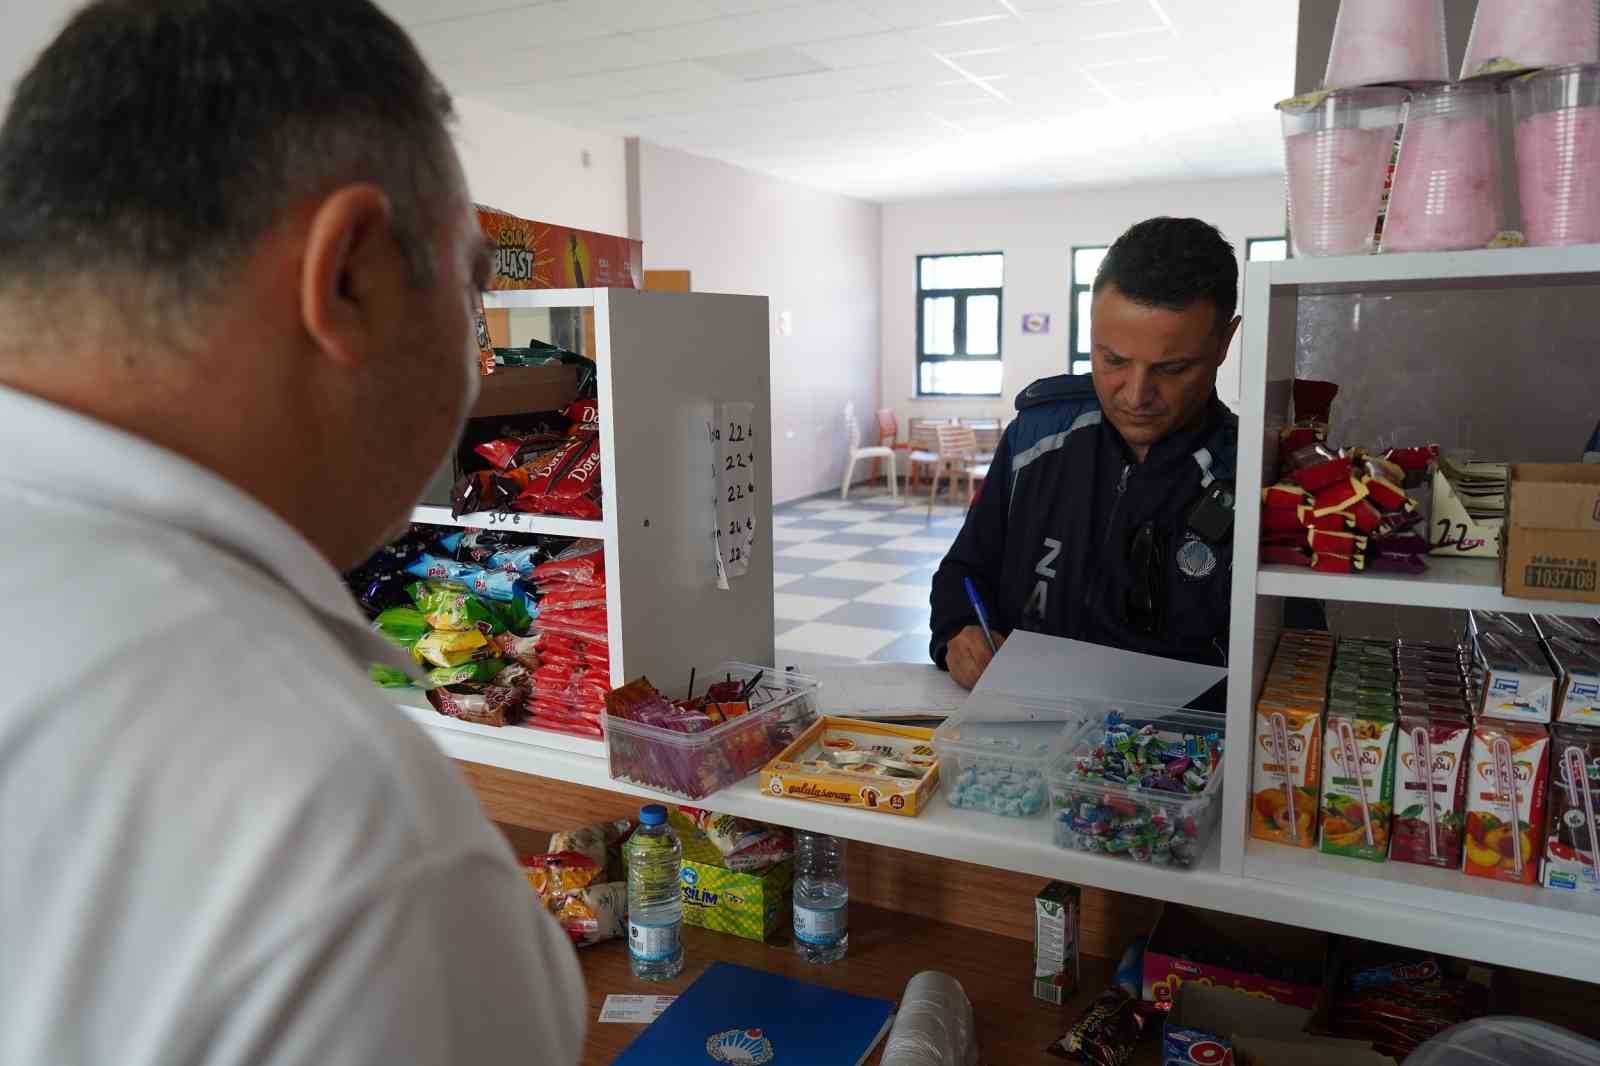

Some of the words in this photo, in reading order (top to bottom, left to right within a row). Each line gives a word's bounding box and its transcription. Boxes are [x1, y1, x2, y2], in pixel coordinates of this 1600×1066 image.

[727, 422, 745, 442] 22
[725, 453, 747, 471] 22
[727, 484, 744, 503] 22
[1437, 518, 1480, 551] 22
[1535, 567, 1594, 590] 1037108
